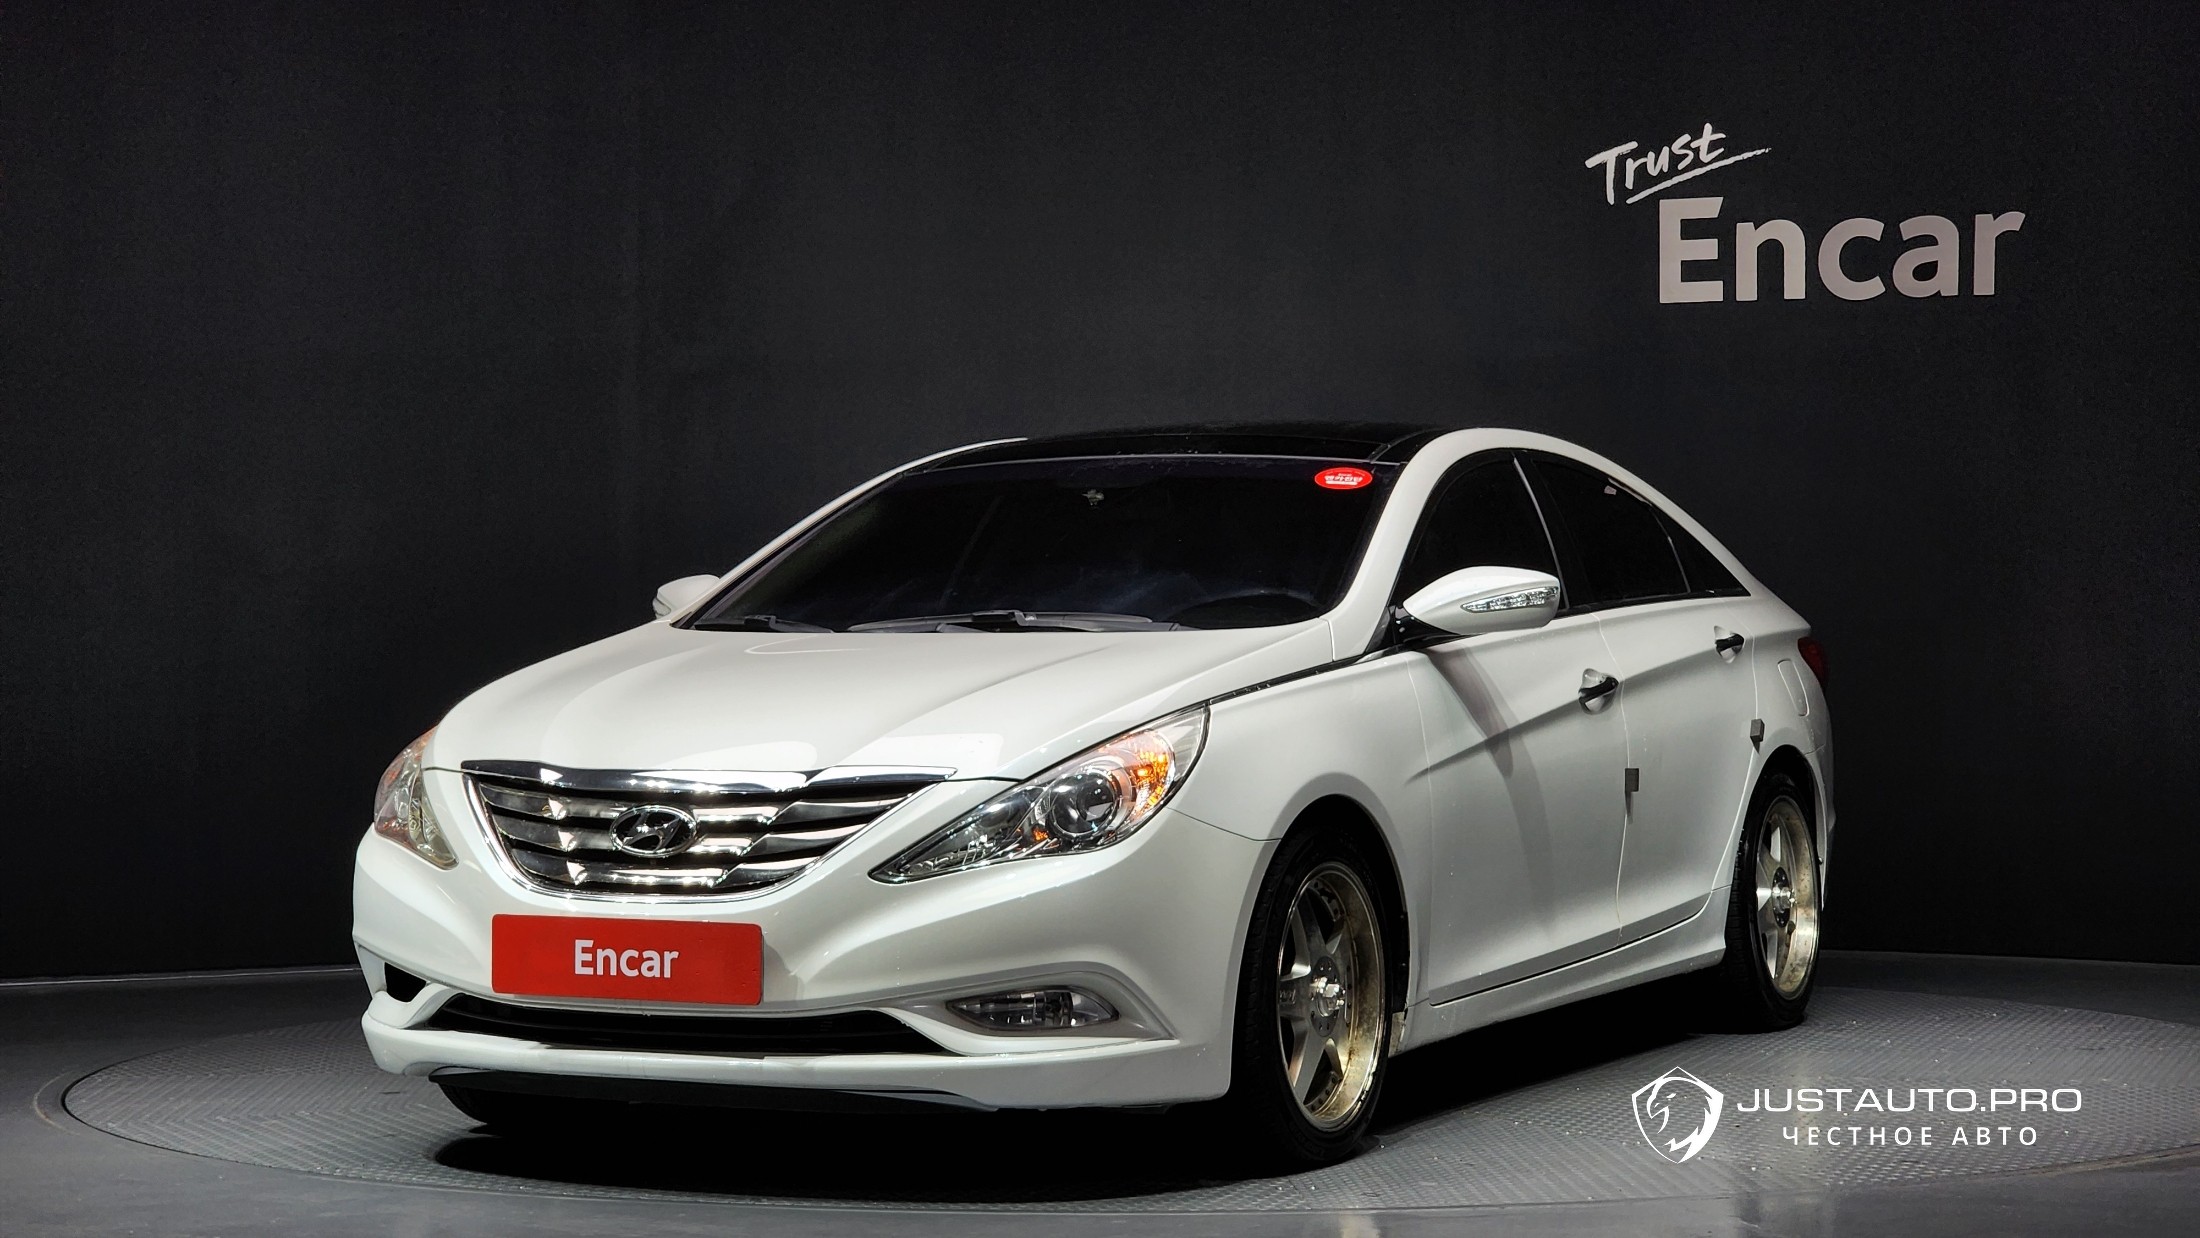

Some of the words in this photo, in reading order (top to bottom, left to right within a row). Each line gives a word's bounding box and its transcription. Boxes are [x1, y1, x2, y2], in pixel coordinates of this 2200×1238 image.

[1584, 122, 1728, 205] Trust
[1659, 196, 2026, 304] Encar
[574, 939, 680, 979] Encar
